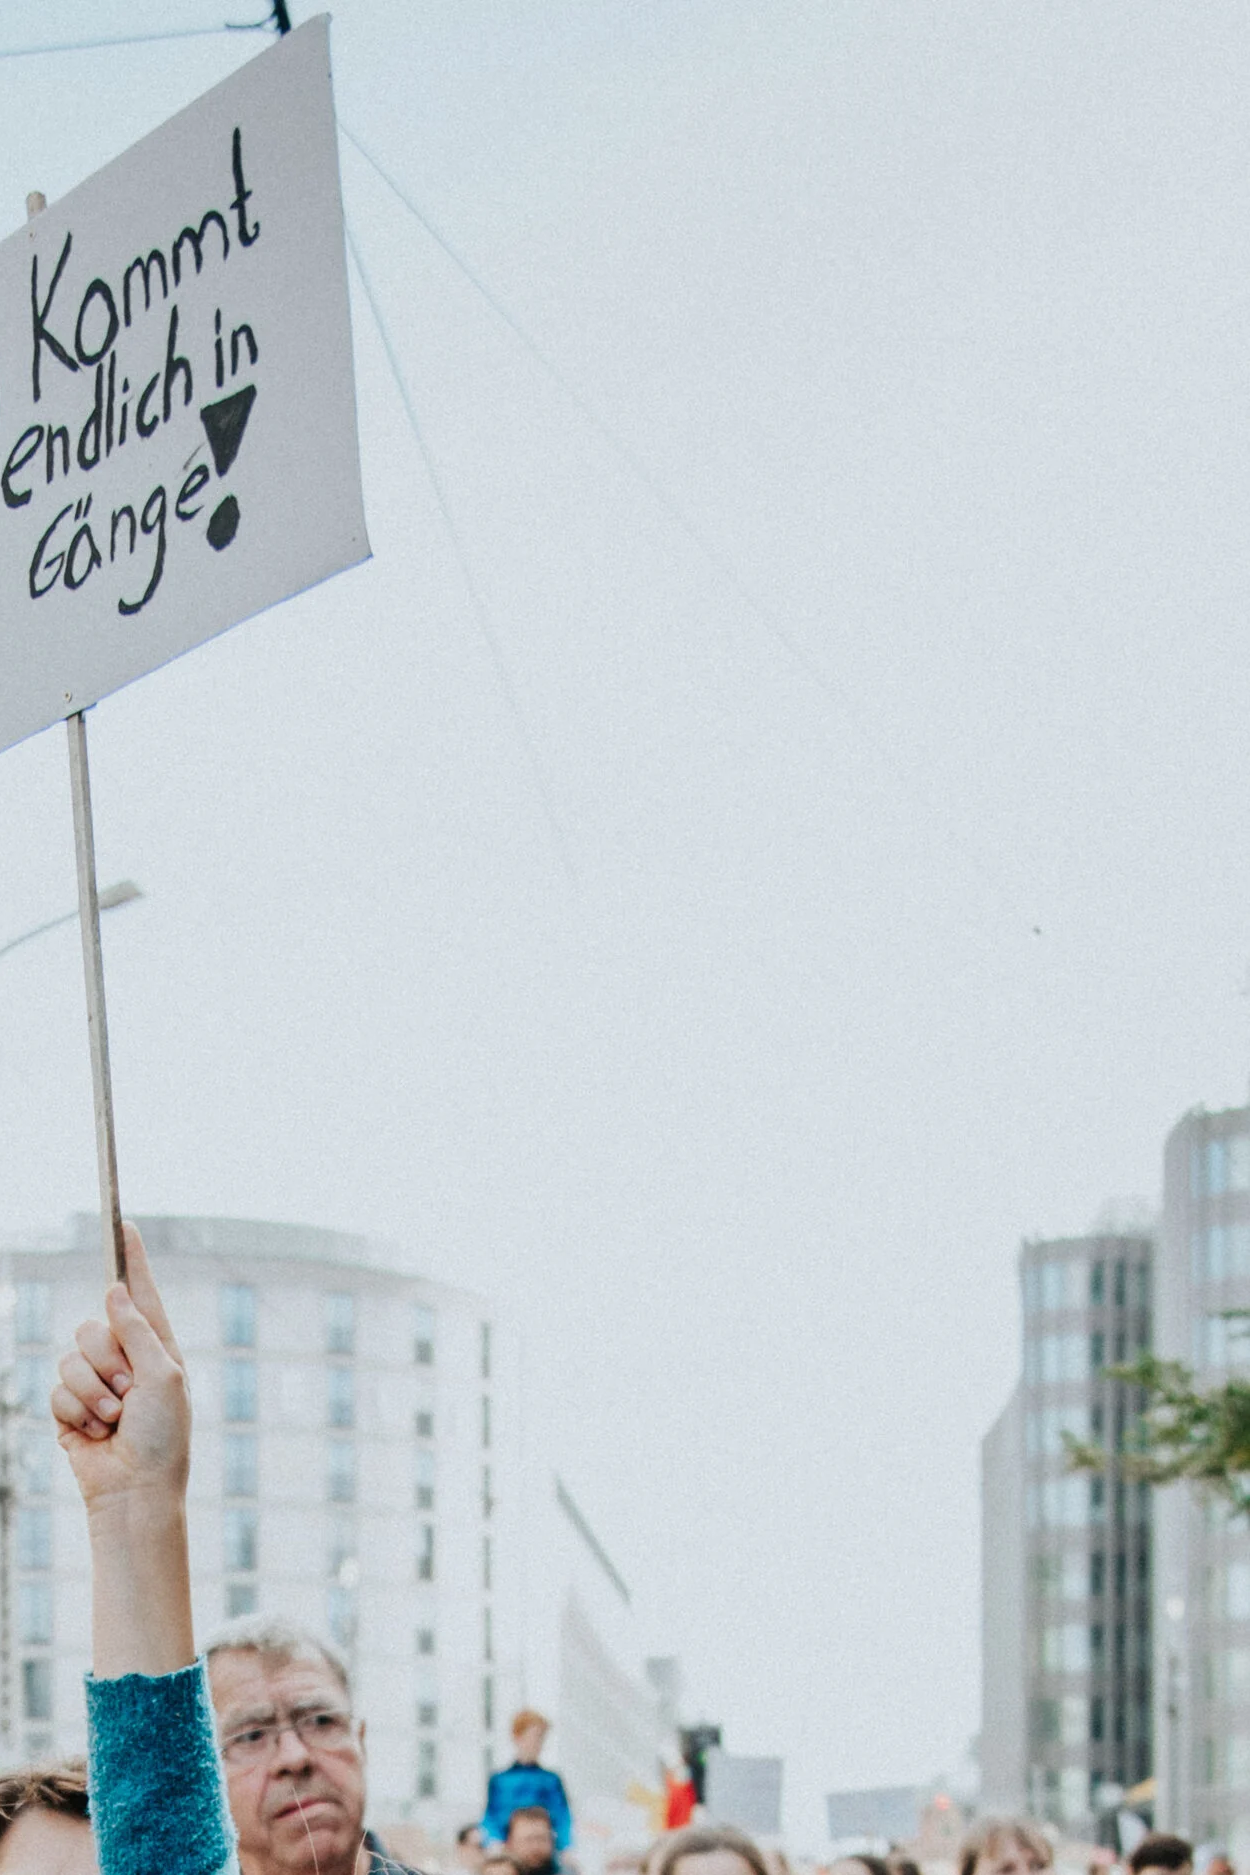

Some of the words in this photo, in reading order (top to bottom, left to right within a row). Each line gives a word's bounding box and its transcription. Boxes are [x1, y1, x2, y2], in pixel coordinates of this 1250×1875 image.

[31, 127, 260, 403] Kommt
[0, 304, 193, 509] endlich
[214, 308, 259, 388] in
[29, 384, 258, 616] Gänge!
